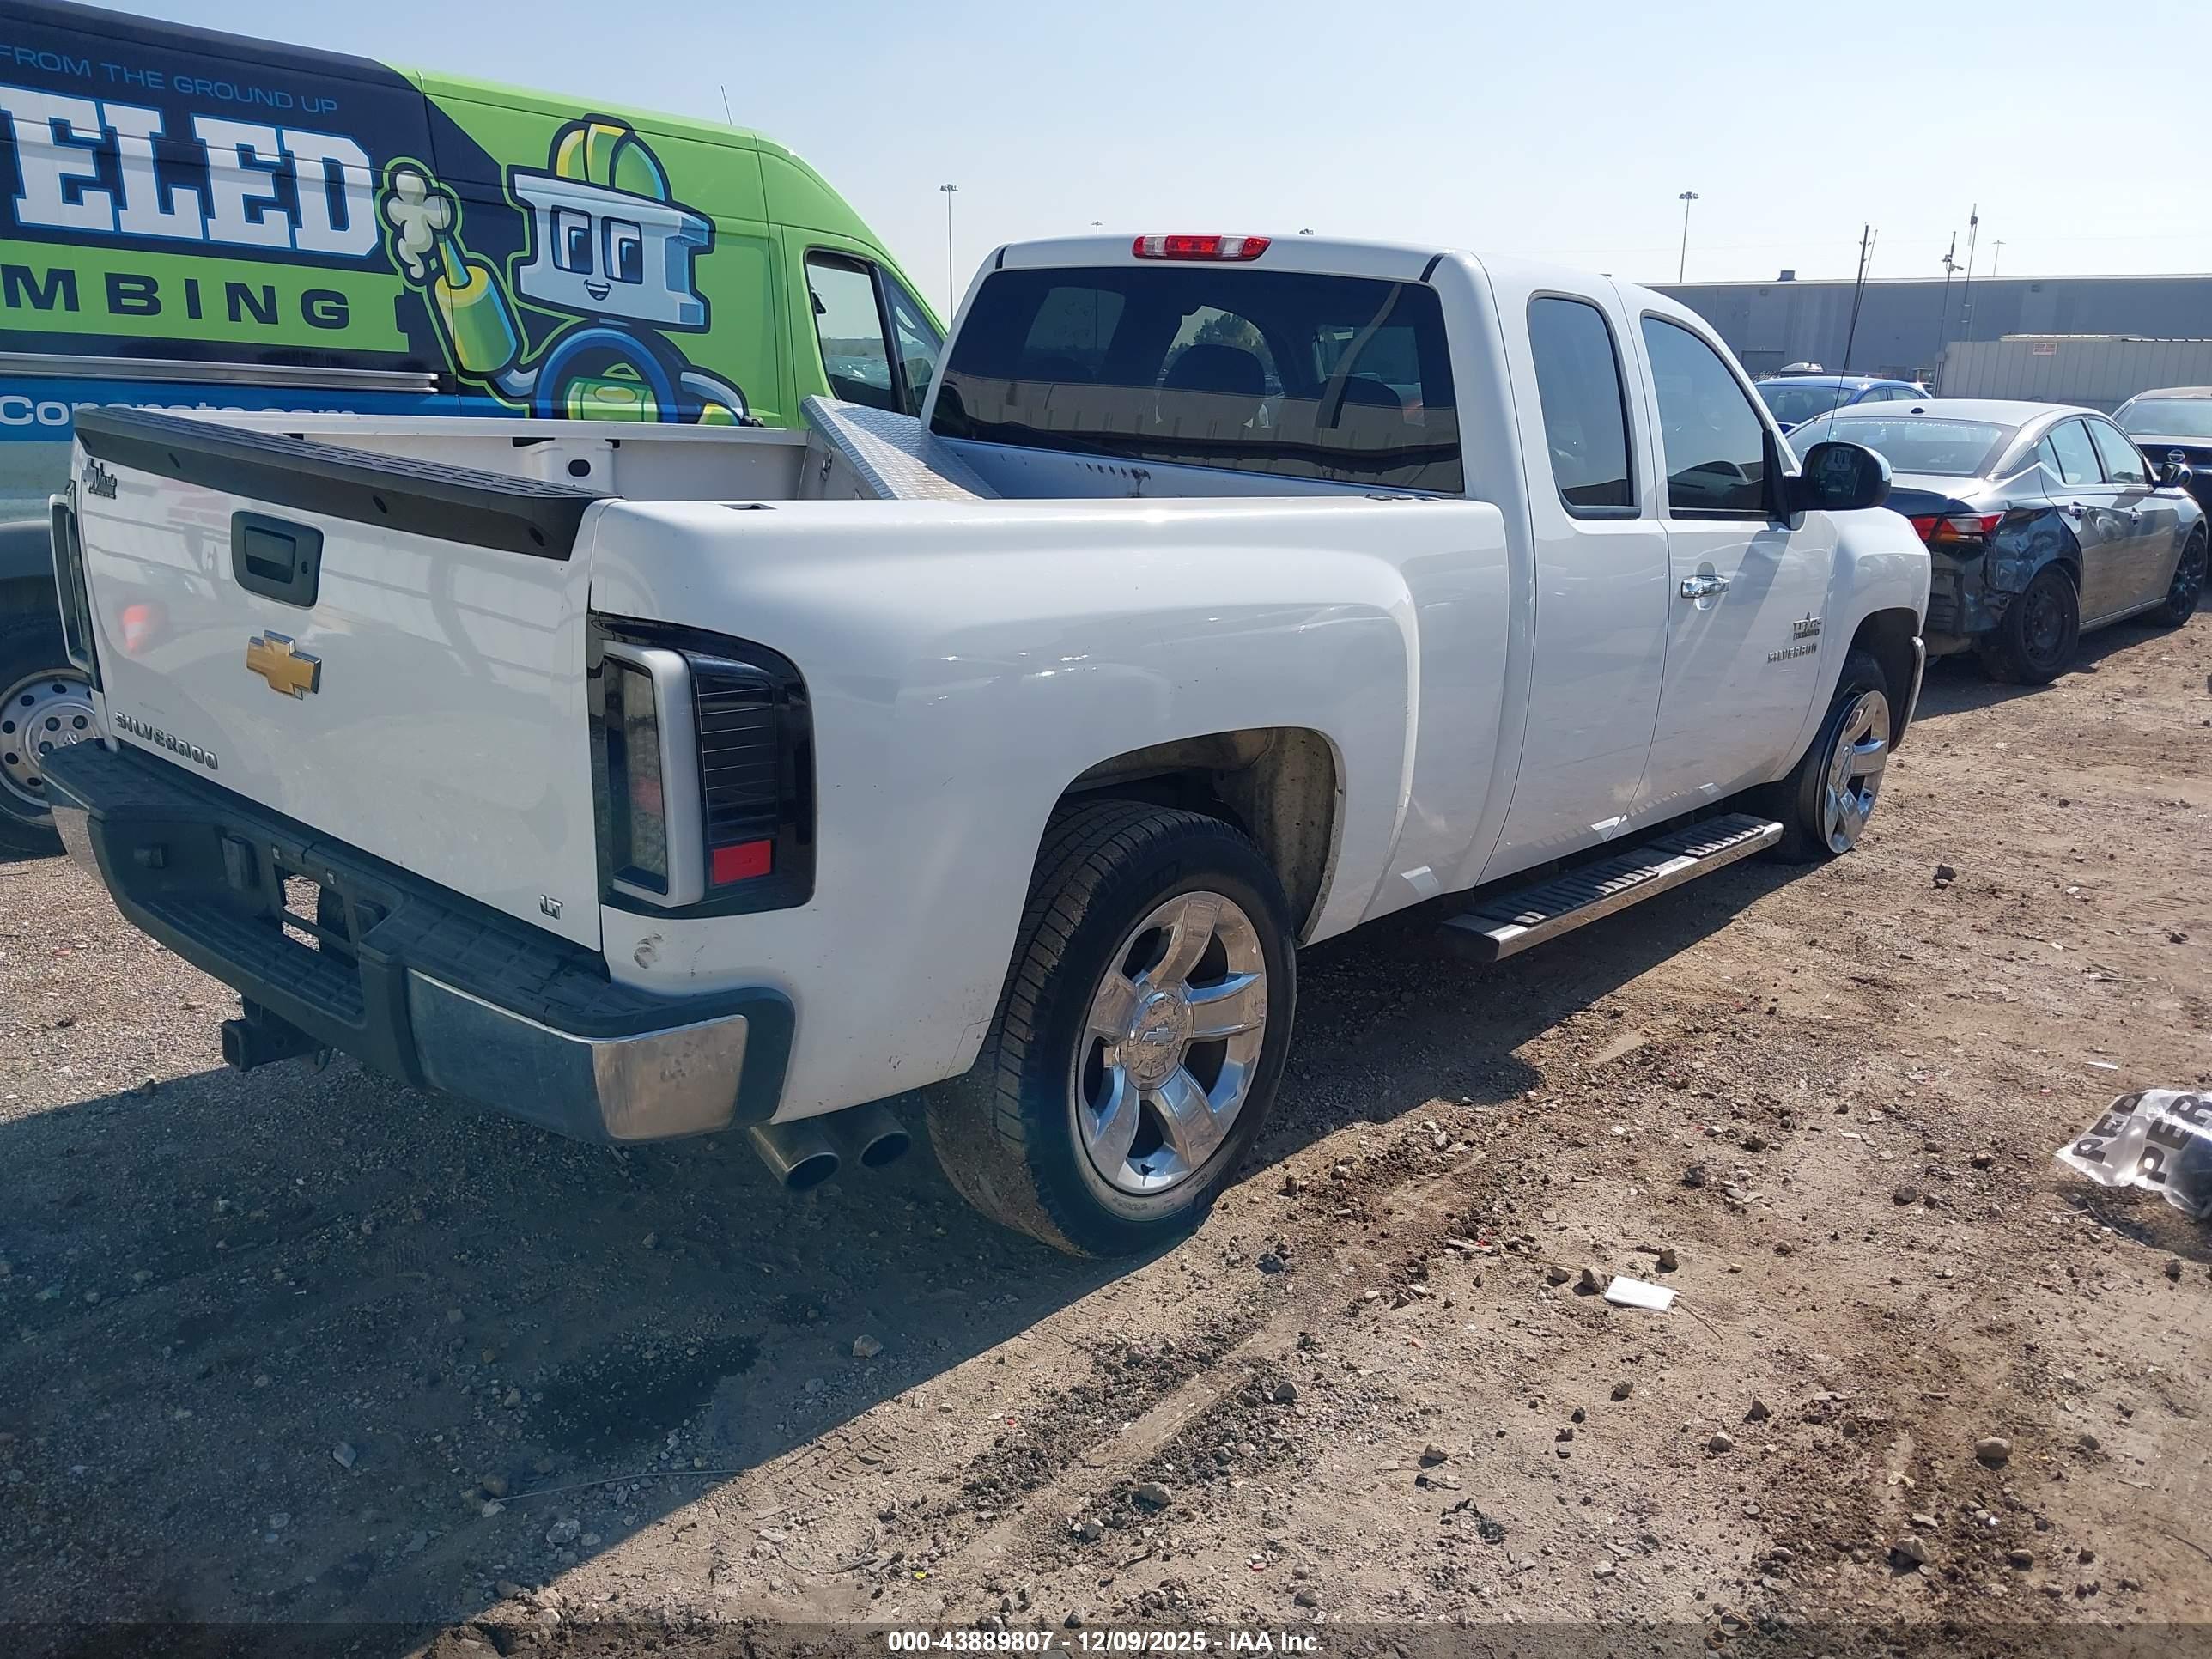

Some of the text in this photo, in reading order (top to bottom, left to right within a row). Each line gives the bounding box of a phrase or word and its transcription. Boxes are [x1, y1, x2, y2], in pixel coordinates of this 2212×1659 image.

[99, 63, 165, 89] THE
[173, 76, 294, 109] GROUND
[301, 96, 337, 114] UP
[0, 264, 350, 330] MBING
[115, 711, 219, 770] SILVERADO
[539, 894, 563, 920] LT
